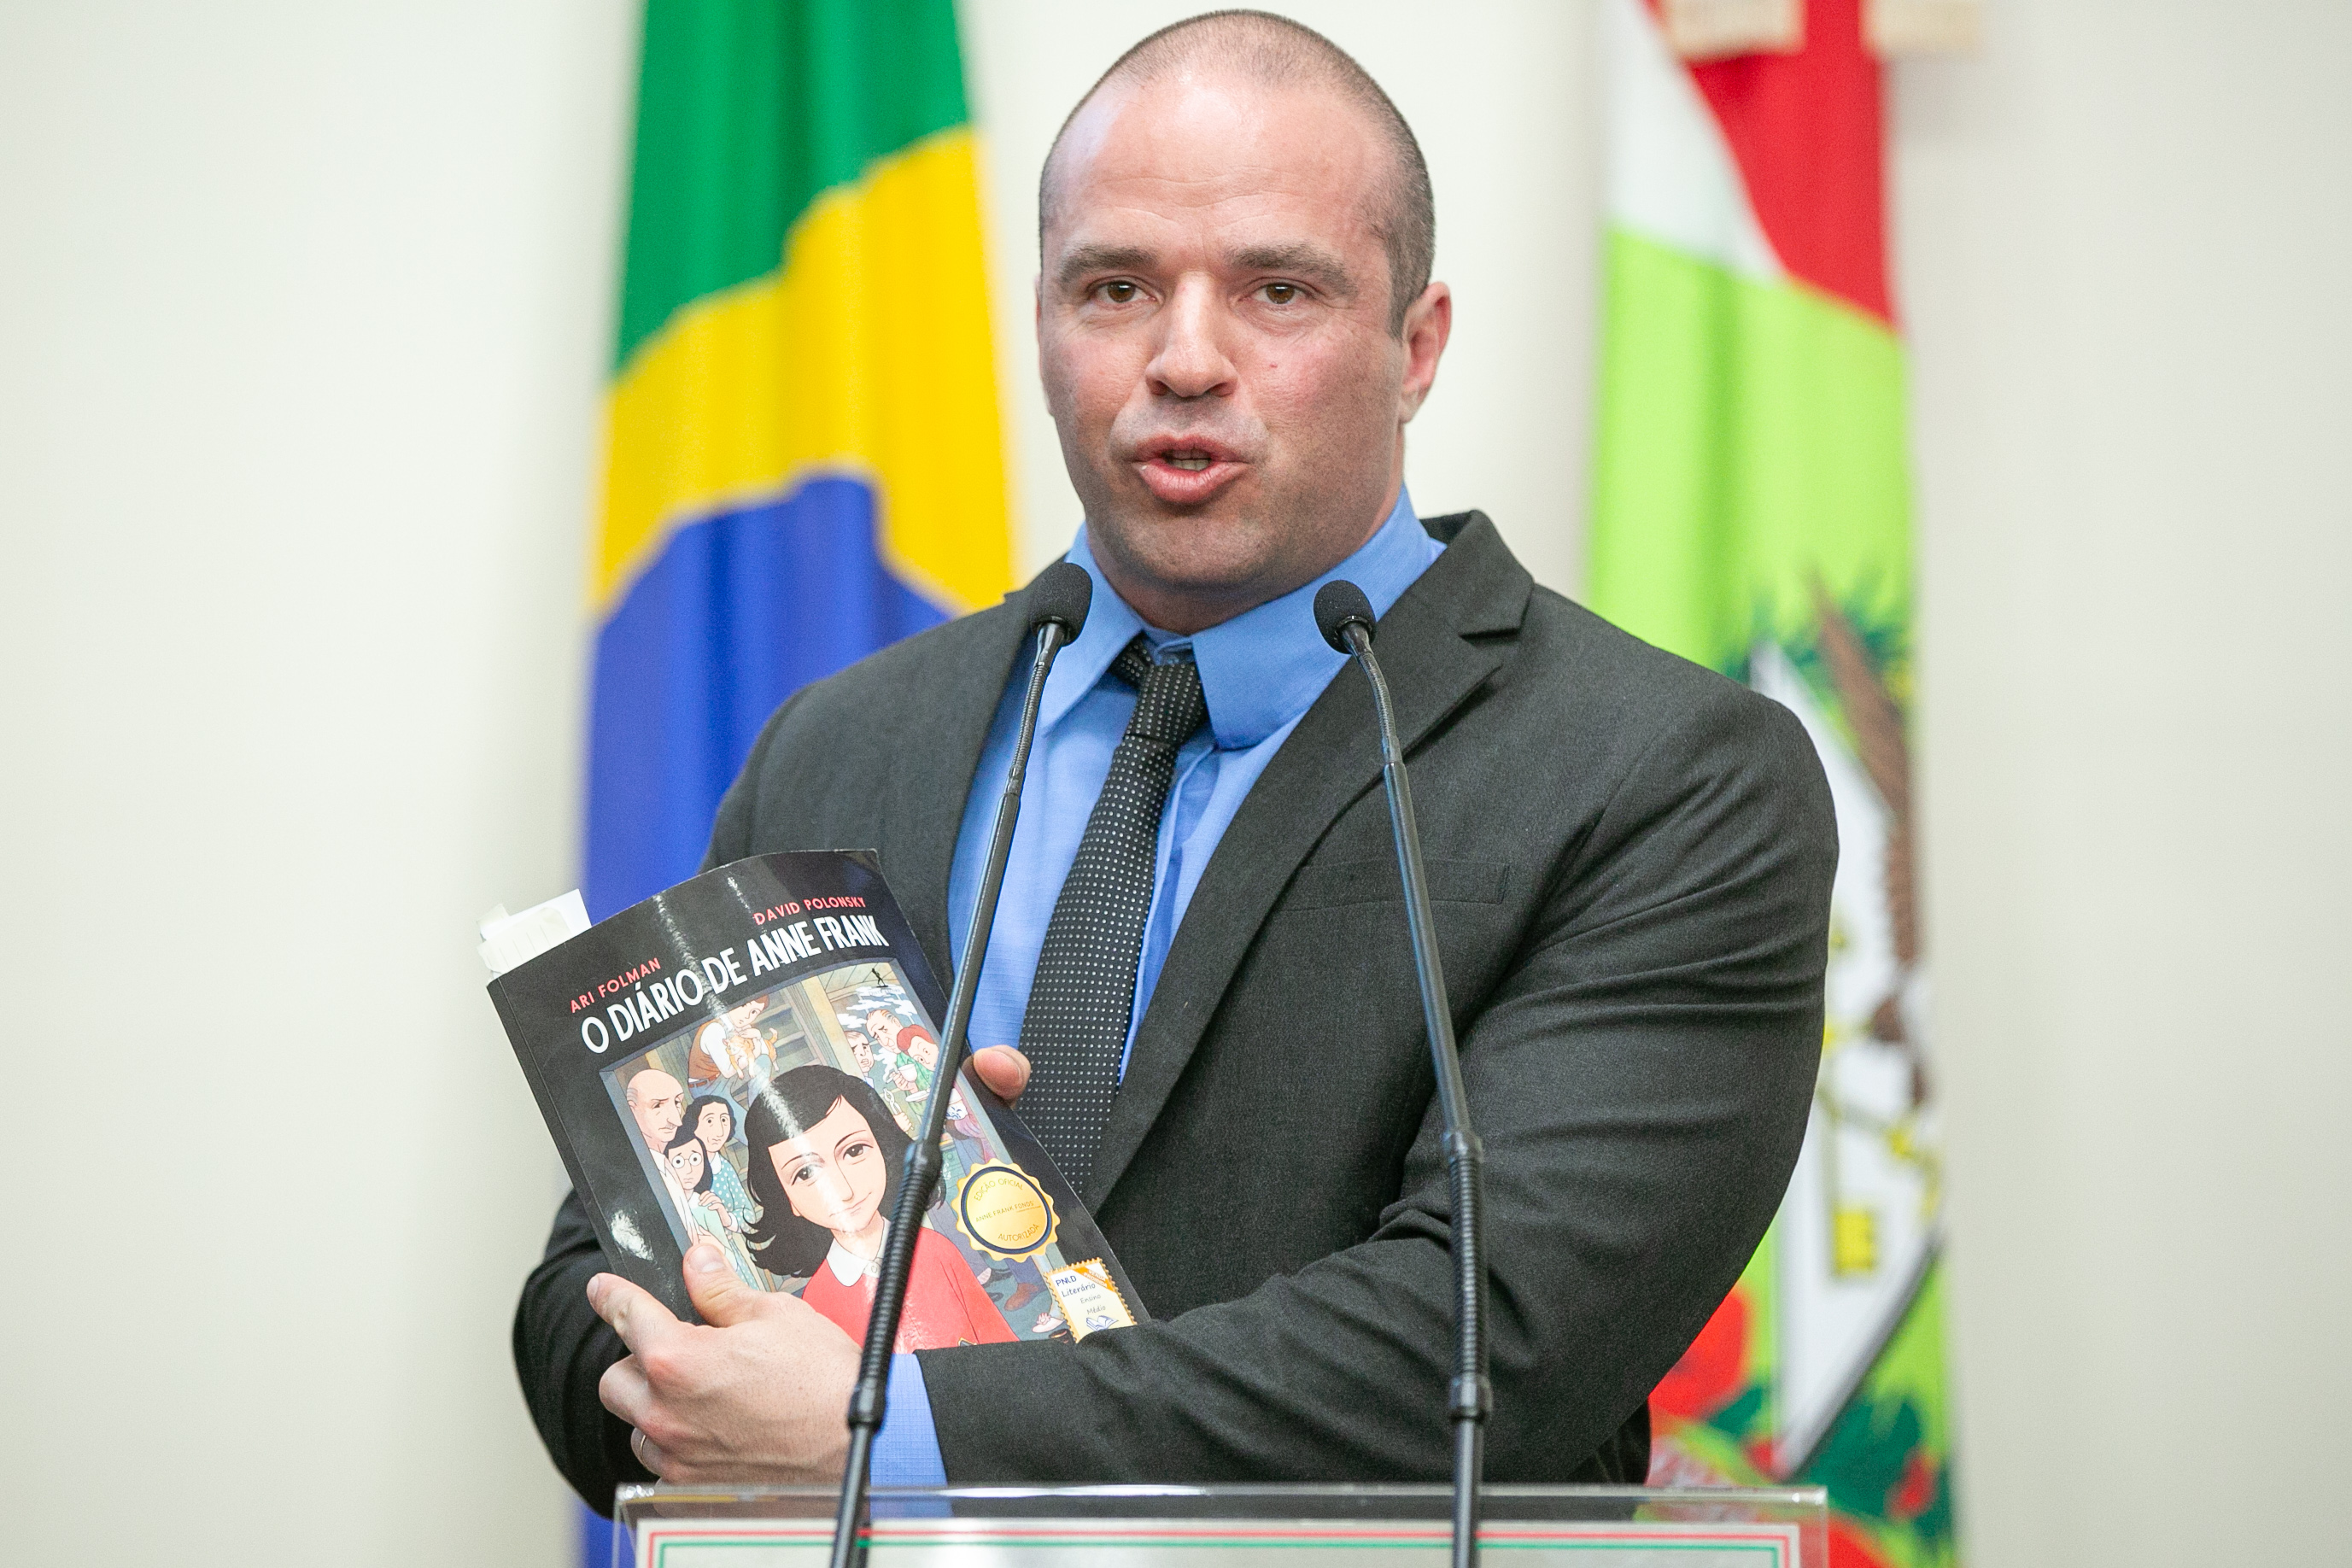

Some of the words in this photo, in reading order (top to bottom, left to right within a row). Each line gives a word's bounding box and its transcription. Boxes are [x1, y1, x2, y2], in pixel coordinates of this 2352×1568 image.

[753, 902, 800, 926] DAVID
[803, 896, 866, 910] POLONSKY
[570, 991, 595, 1013] ARI
[598, 957, 661, 998] FOLMAN
[581, 1016, 609, 1054] O
[606, 968, 703, 1042] DIÁRIO
[700, 947, 747, 995] DE
[746, 921, 822, 977] ANNE
[813, 915, 890, 951] FRANK
[974, 1180, 996, 1202] EDIÇÃO
[998, 1178, 1023, 1191] OFICIAL
[975, 1213, 992, 1222] ANNE
[992, 1205, 1014, 1216] FRANK
[1015, 1200, 1034, 1210] FONDS
[998, 1224, 1039, 1242] AUTORIZADA
[1055, 1275, 1077, 1286] PNLD
[1062, 1283, 1096, 1297] Literário
[1079, 1294, 1102, 1304] Ensino
[1086, 1305, 1106, 1315] Médio
